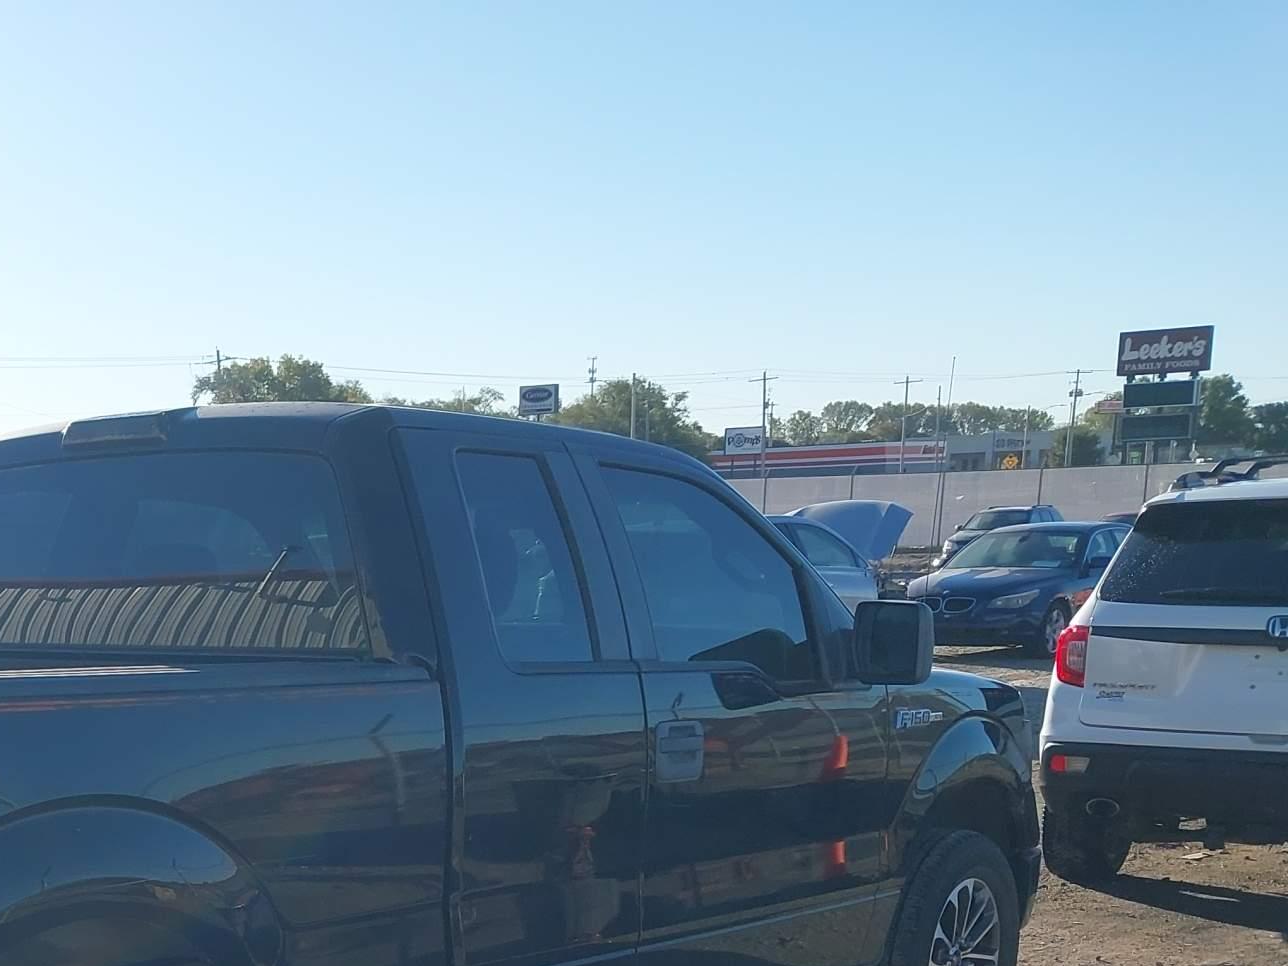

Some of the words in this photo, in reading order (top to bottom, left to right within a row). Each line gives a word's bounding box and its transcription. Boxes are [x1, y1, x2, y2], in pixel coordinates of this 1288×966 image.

[1121, 335, 1207, 361] Leeker's
[1124, 362, 1162, 371] FAMILY
[1165, 359, 1201, 369] FOODS
